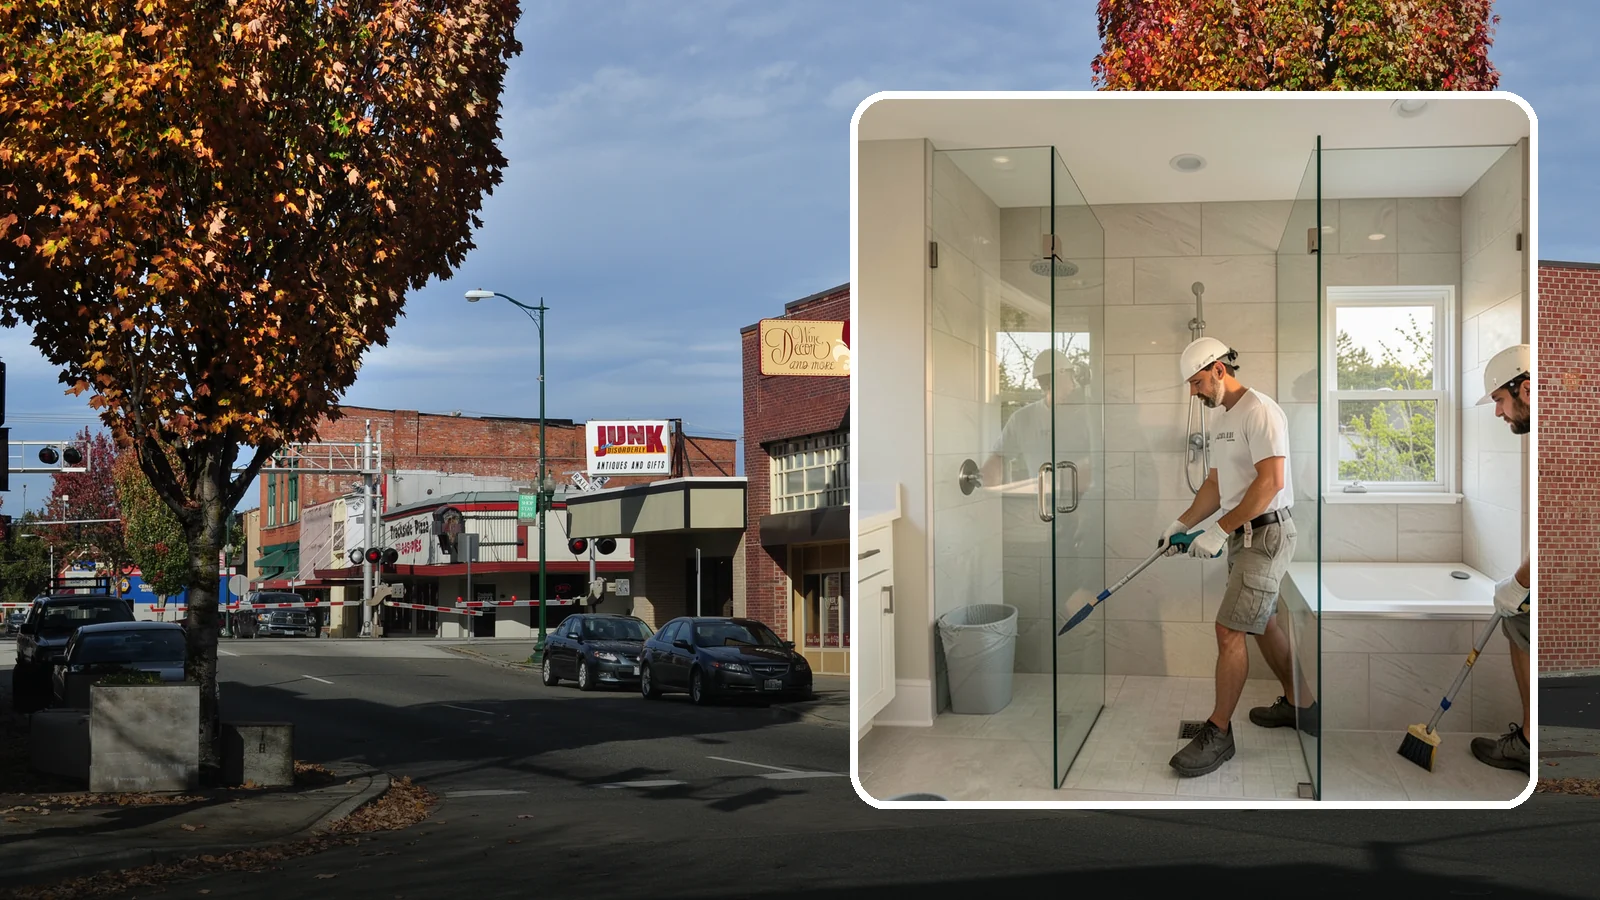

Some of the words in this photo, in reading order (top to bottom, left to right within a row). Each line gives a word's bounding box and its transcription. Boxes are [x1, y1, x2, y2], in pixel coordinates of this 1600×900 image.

[596, 425, 665, 457] JUNK
[607, 446, 646, 454] DISORDERLY
[597, 461, 628, 470] ANTIQUES
[631, 461, 644, 470] AND
[647, 460, 665, 469] GIFTS
[390, 521, 413, 539] Trackside
[414, 520, 429, 534] Pizza
